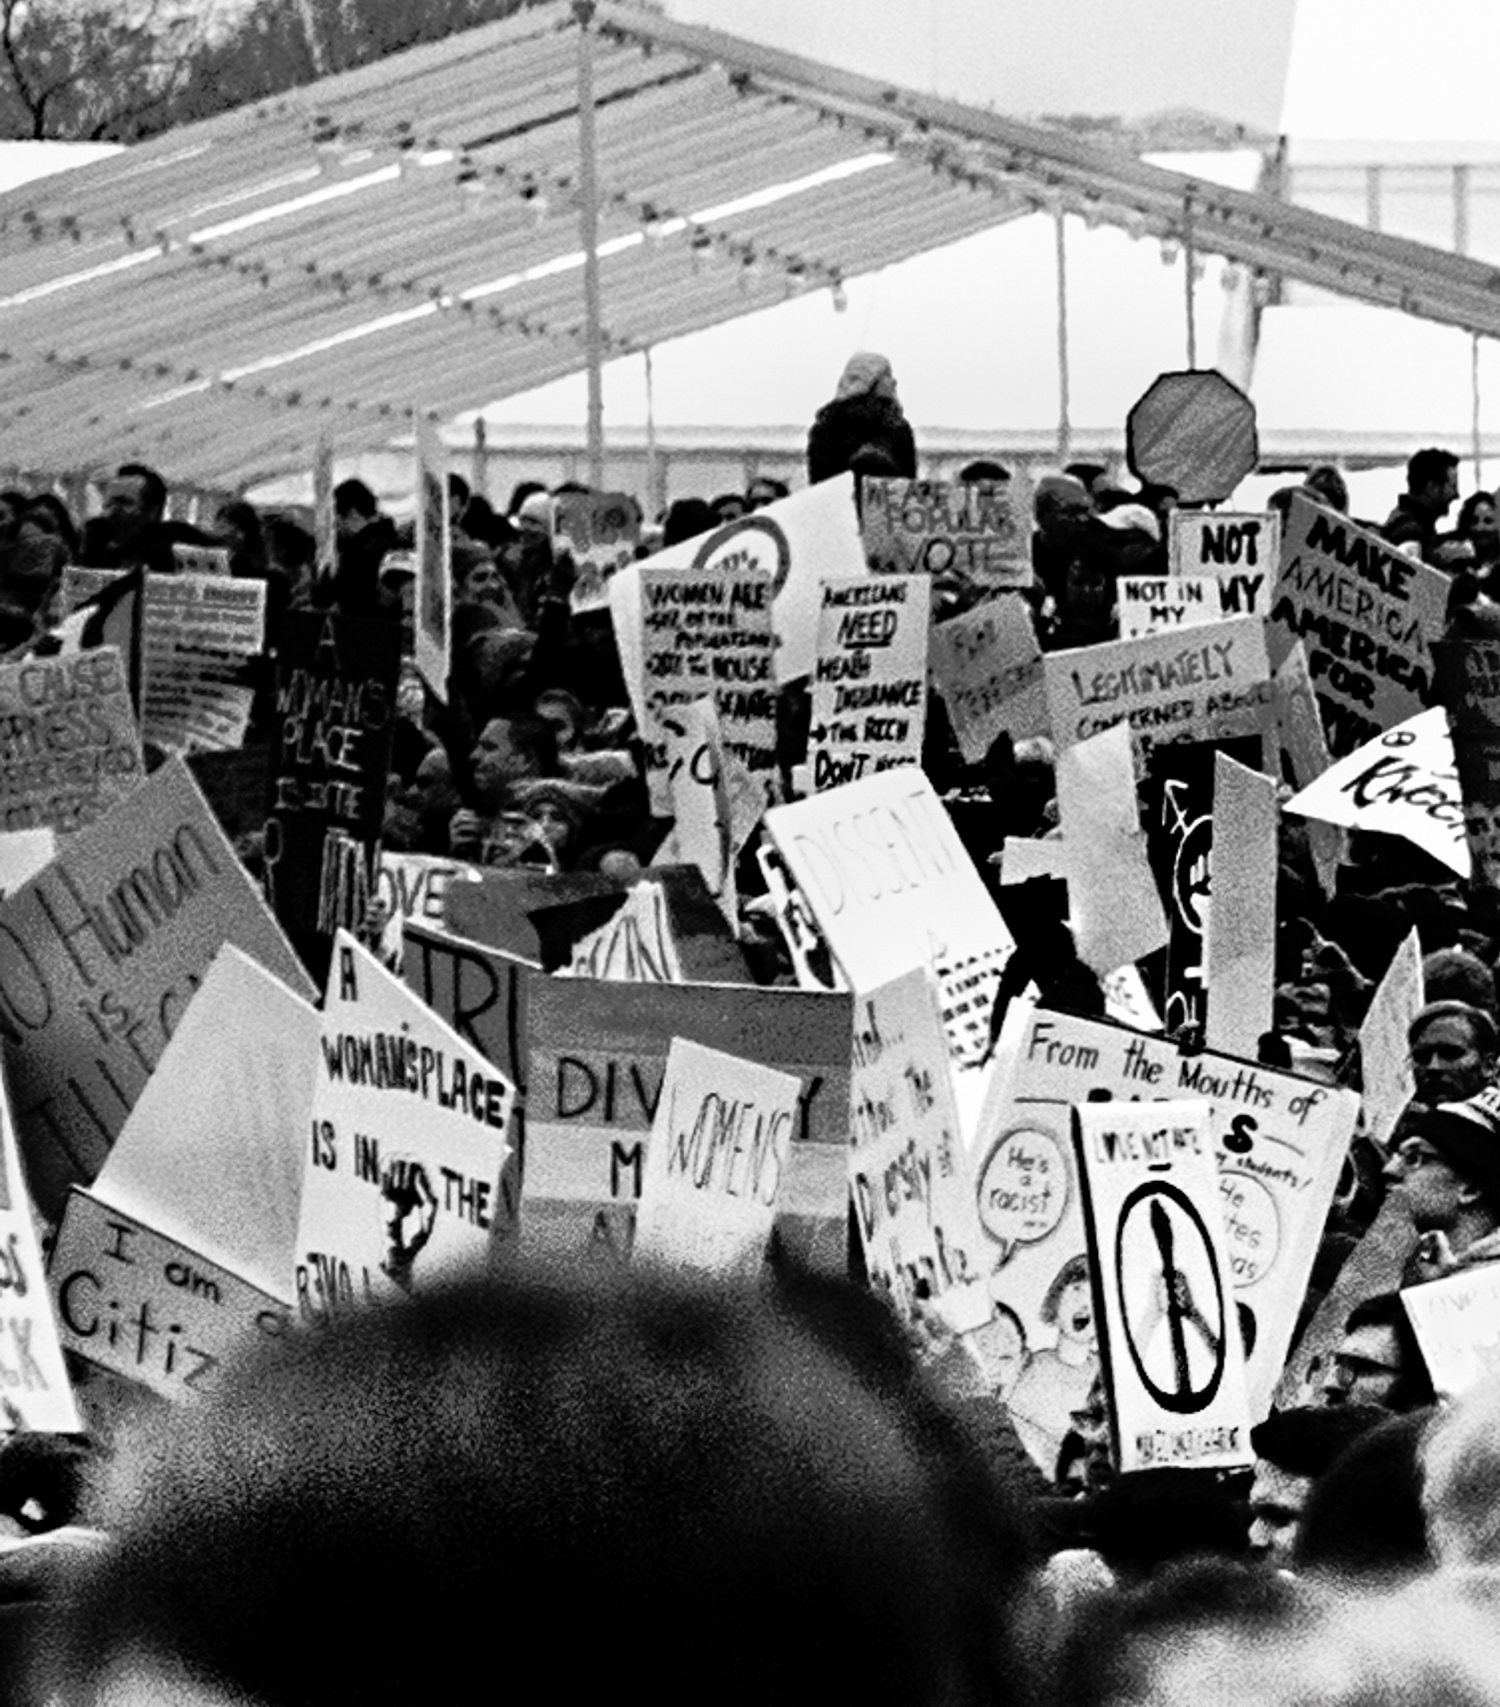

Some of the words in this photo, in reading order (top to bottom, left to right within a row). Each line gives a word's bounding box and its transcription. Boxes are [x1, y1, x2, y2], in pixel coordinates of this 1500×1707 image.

[1201, 521, 1260, 566] NOT
[1306, 515, 1416, 601] MAKE
[837, 609, 898, 645] NEED
[1125, 581, 1168, 602] NOT
[1177, 581, 1203, 603] IN
[1151, 606, 1186, 624] MY
[1282, 556, 1424, 653] AMERICA
[1309, 649, 1376, 710] FOR
[340, 946, 358, 1002] A
[420, 1046, 507, 1130] PLACE
[1028, 1022, 1099, 1071] From
[1123, 1038, 1164, 1085] the
[1178, 1059, 1275, 1109] Mouths
[1288, 1087, 1329, 1126] of
[312, 1119, 337, 1171] IS
[354, 1133, 380, 1185] IN
[440, 1165, 491, 1230] THE
[103, 1221, 137, 1266] I
[163, 1261, 221, 1306] am
